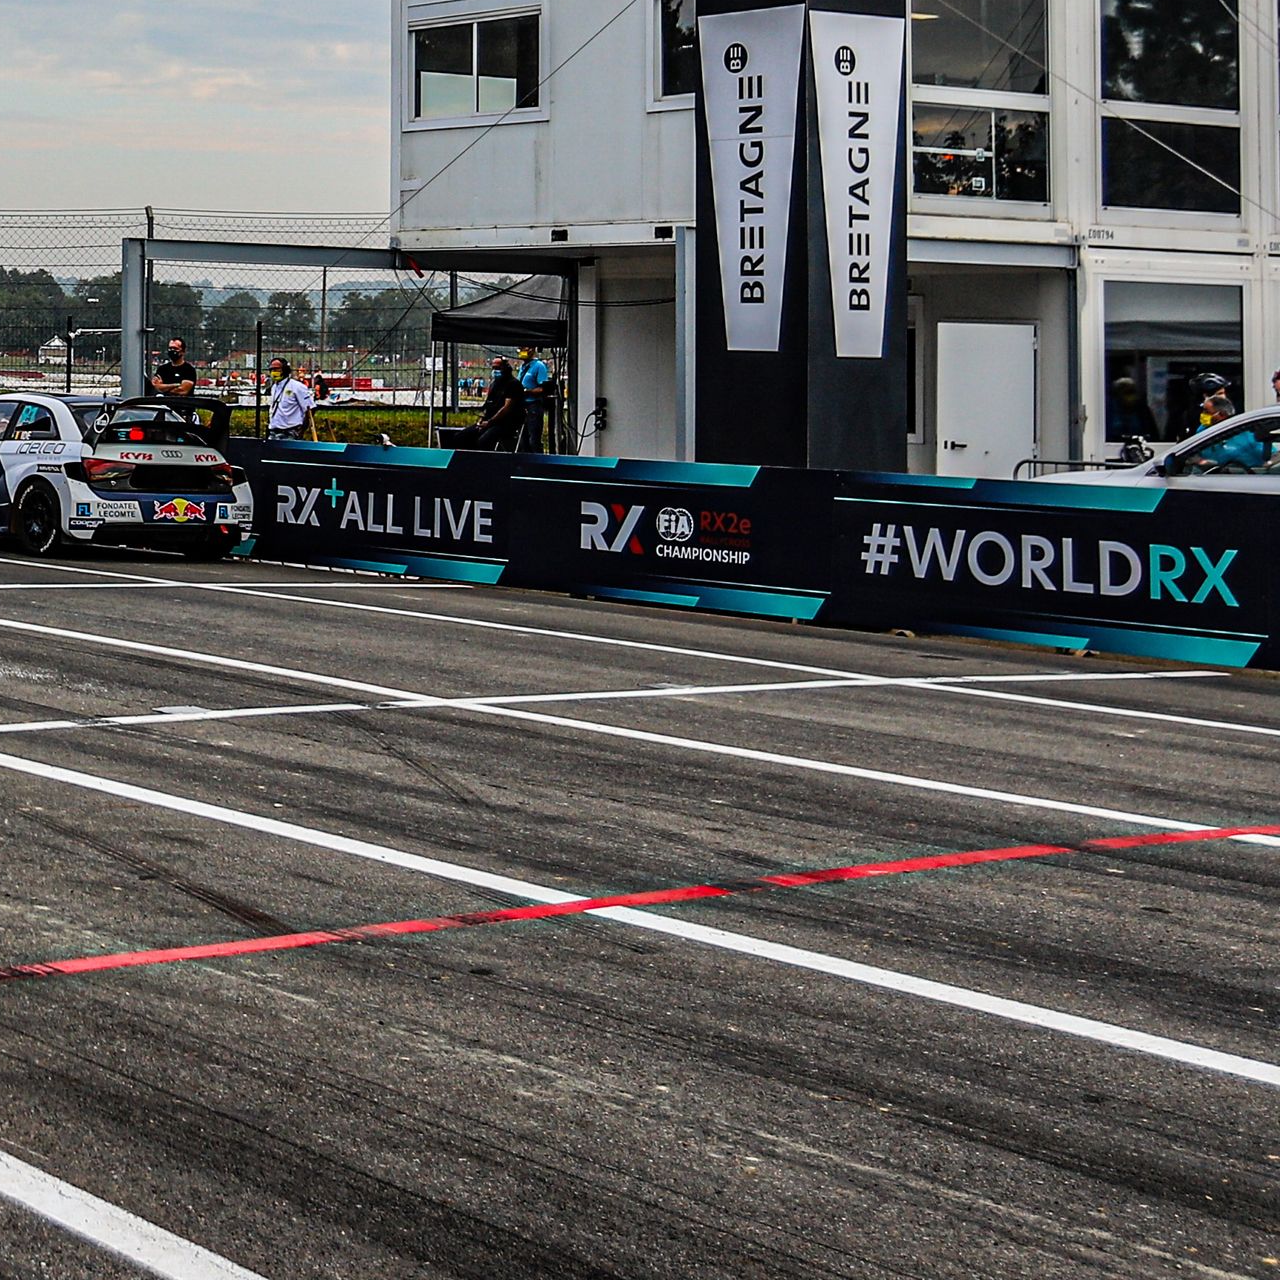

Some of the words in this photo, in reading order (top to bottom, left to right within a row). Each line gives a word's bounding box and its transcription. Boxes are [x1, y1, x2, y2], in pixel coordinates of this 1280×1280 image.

[738, 74, 766, 305] BRETAGNE
[847, 80, 871, 312] BRETAGNE
[120, 452, 153, 461] KYB
[97, 502, 138, 510] FONDATEL
[98, 510, 136, 518] LECOMTE
[414, 496, 493, 543] LIVE
[700, 511, 752, 534] RX2e
[580, 501, 645, 555] RX
[656, 544, 750, 565] CHAMPIONSHIP
[861, 523, 1239, 608] #WORLDRX
